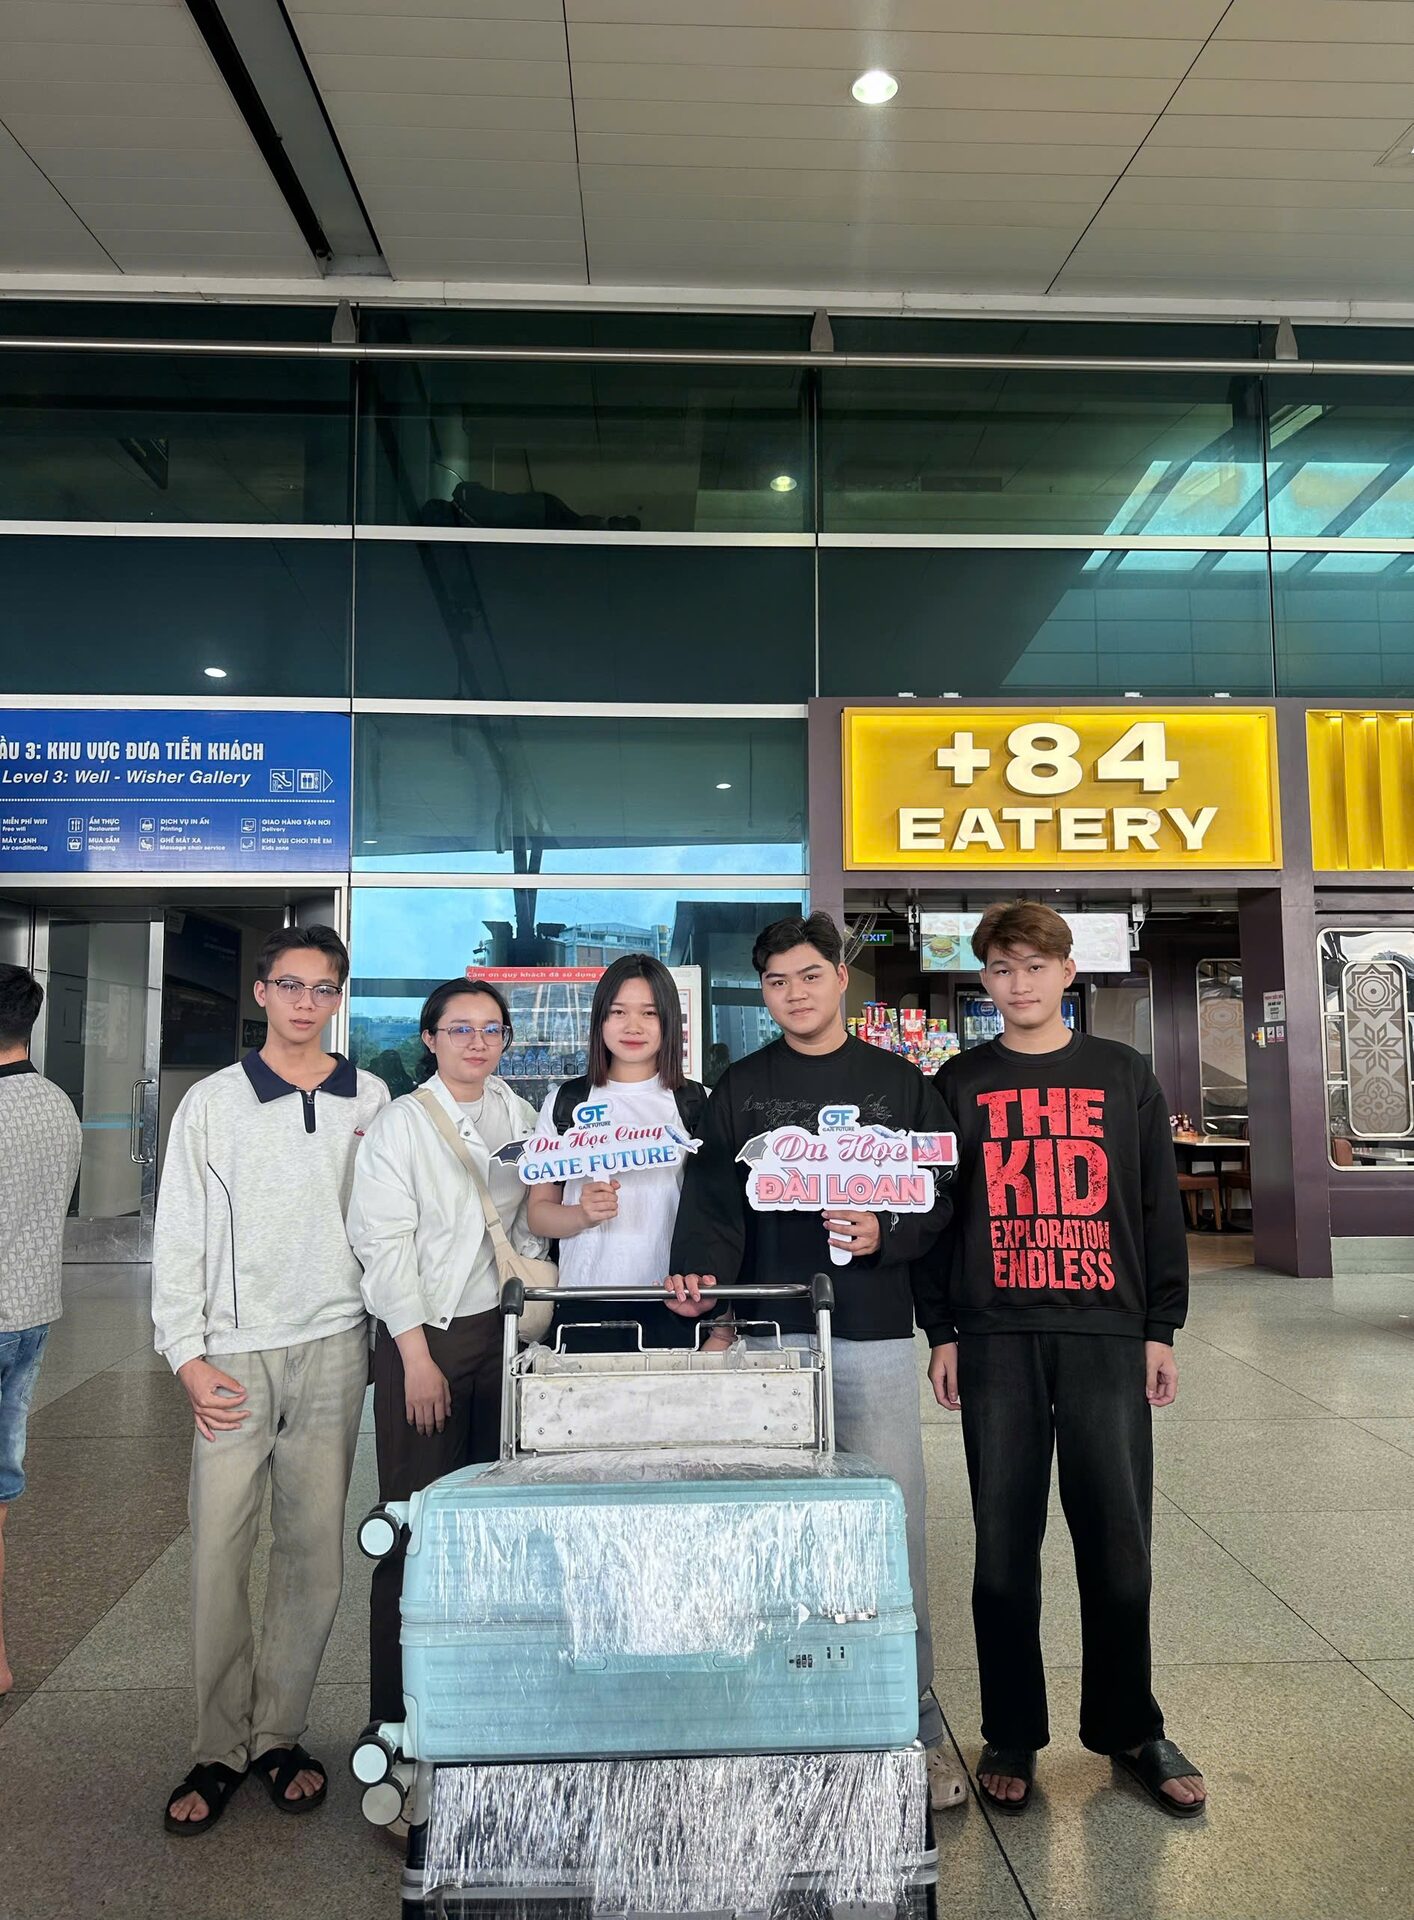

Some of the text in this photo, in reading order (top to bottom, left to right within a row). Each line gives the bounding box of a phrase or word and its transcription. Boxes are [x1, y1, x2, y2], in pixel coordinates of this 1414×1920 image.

[25, 742, 41, 760] 3:
[47, 742, 81, 760] KHU
[87, 741, 120, 764] VỰC
[125, 741, 160, 760] ĐƯA
[165, 736, 202, 760] TIỄN
[208, 739, 264, 760] KHÁCH
[935, 721, 1180, 796] +84
[2, 770, 48, 783] Level
[53, 770, 69, 783] 3:
[75, 770, 110, 783] Well
[126, 770, 185, 783] Wisher
[190, 770, 251, 787] Gallery
[160, 818, 178, 826] DỊCH
[897, 807, 1218, 852] EATERY
[977, 1088, 1105, 1138] THE
[529, 1136, 560, 1153] Du
[569, 1132, 608, 1148] Học
[772, 1134, 908, 1167] Du Học
[523, 1145, 677, 1181] GATE FUTURE
[983, 1139, 1109, 1216] KID
[755, 1167, 926, 1205] ĐÀI LOAN
[990, 1219, 1110, 1249] EXPLORATION
[993, 1249, 1115, 1290] ENDLESS
